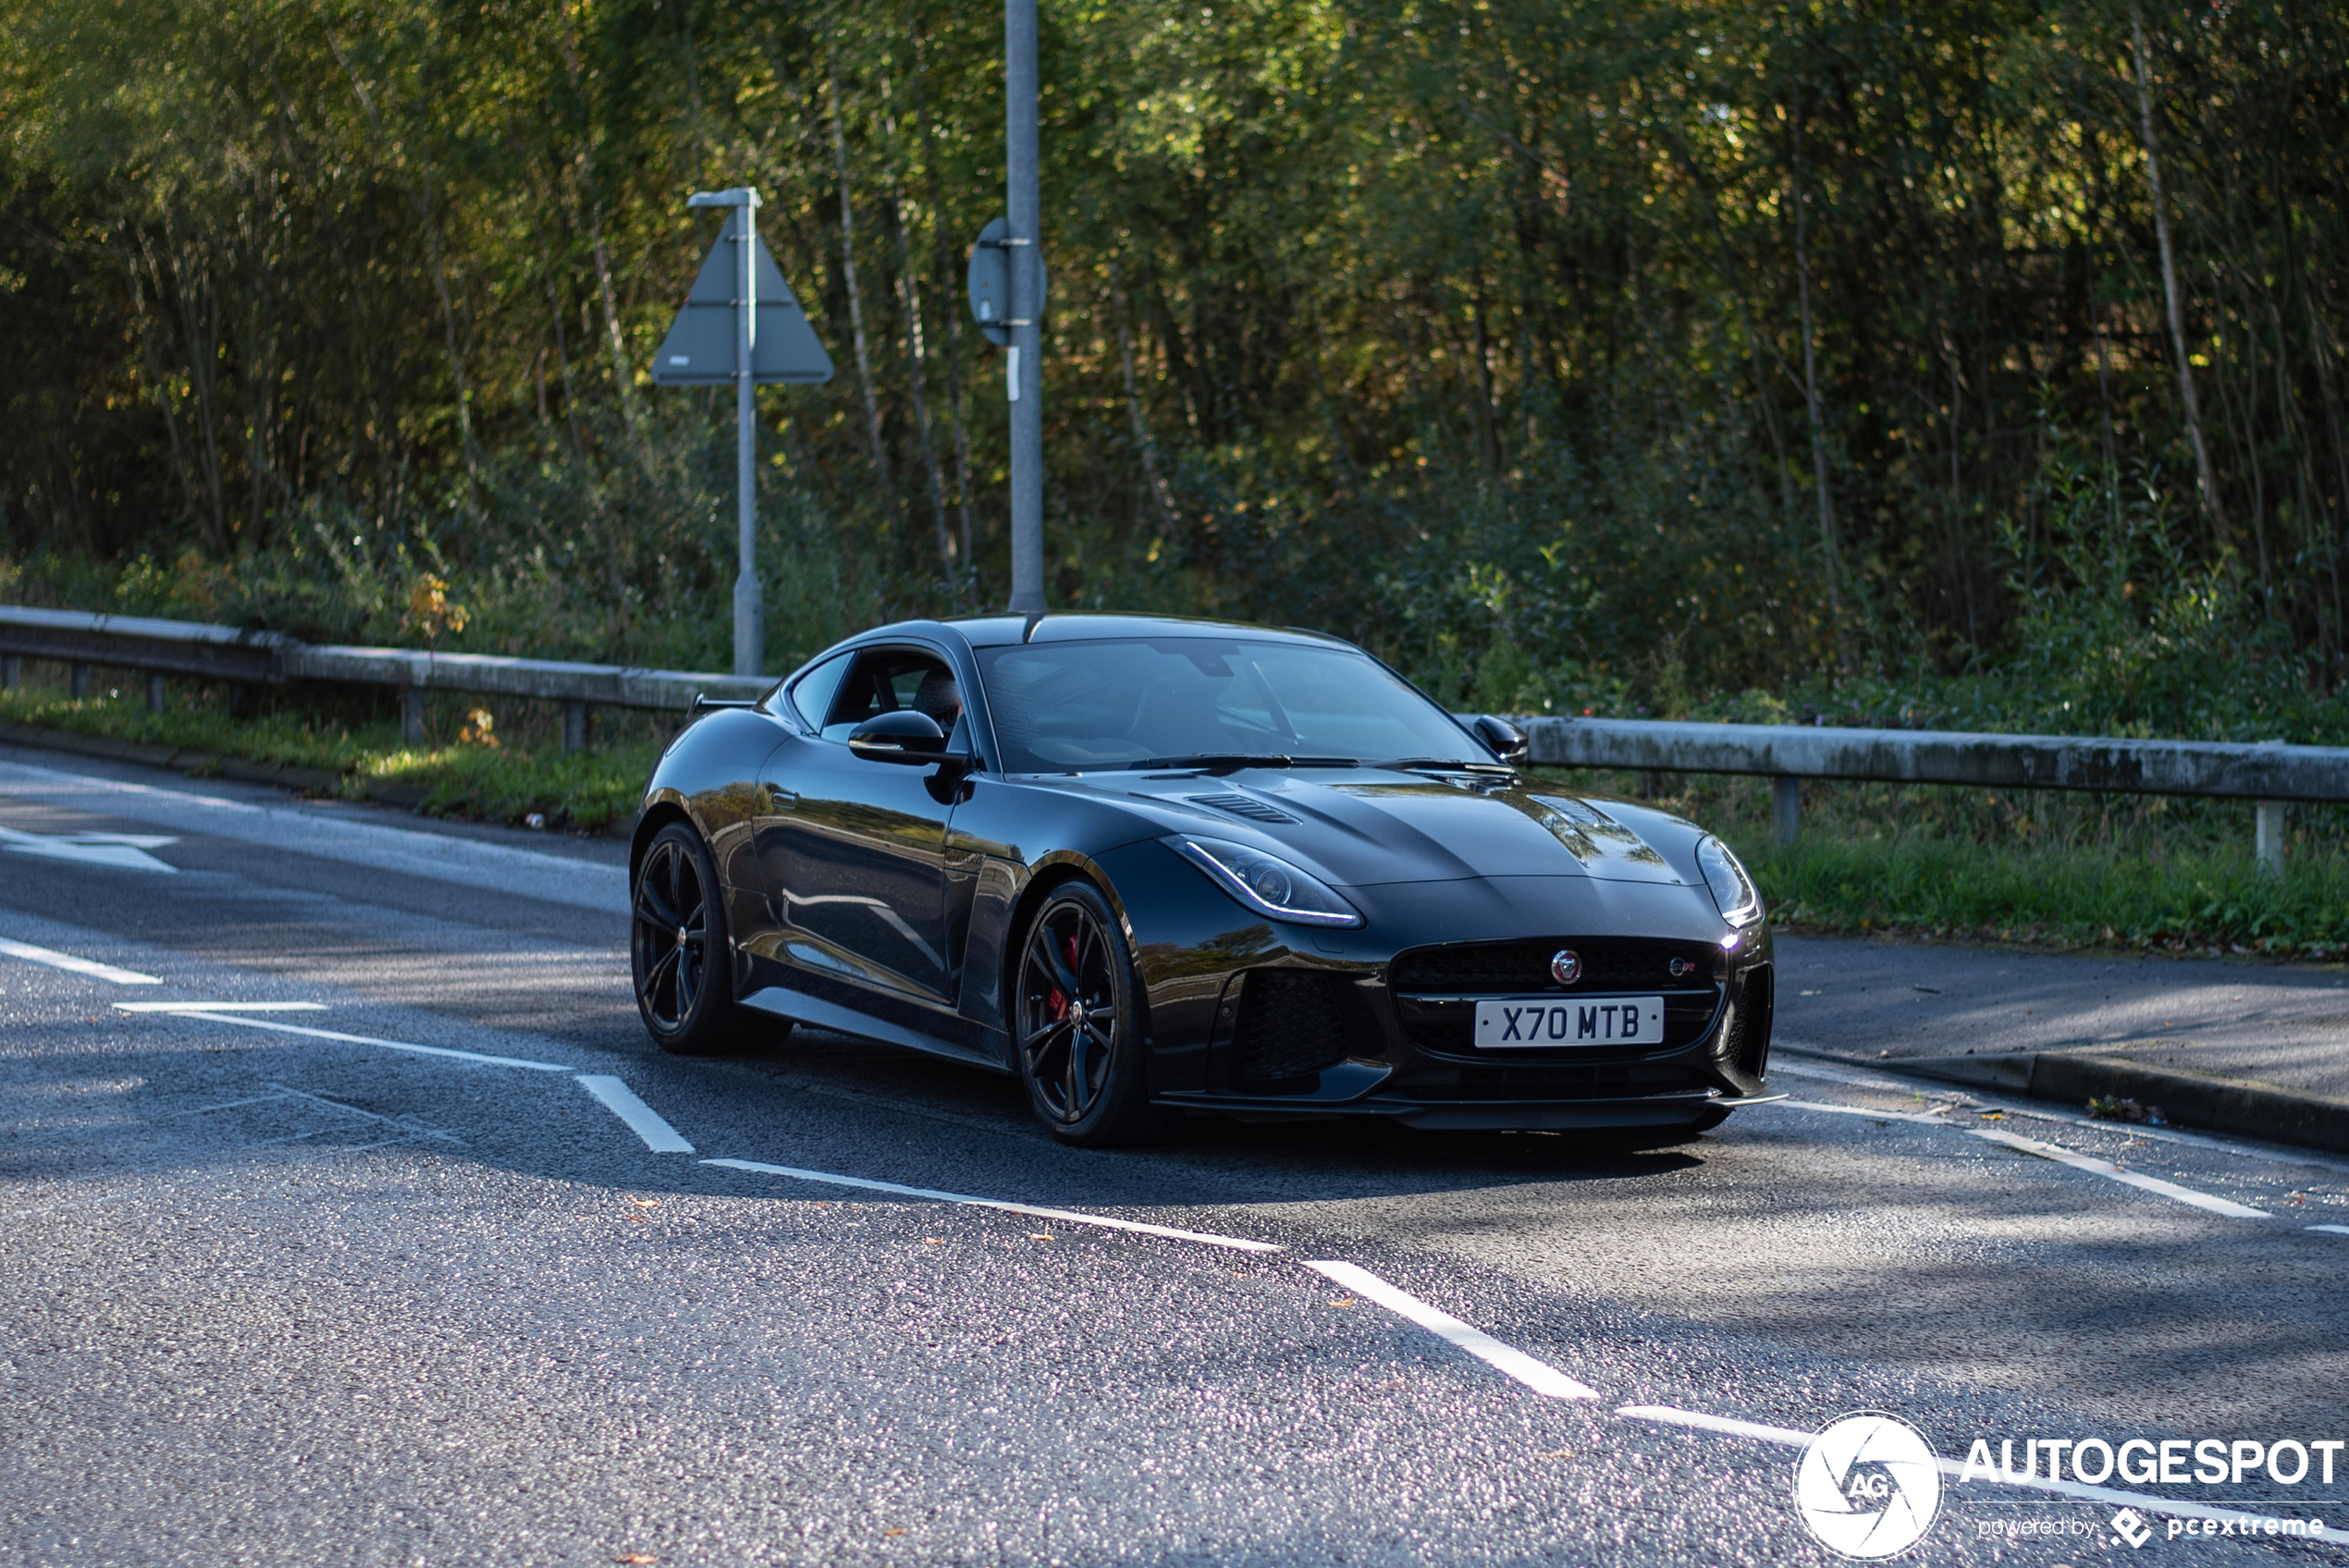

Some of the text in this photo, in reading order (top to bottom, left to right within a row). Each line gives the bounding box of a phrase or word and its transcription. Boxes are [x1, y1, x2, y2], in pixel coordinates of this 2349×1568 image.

[1669, 960, 1695, 974] SVR
[1501, 1004, 1639, 1041] X70 MTB
